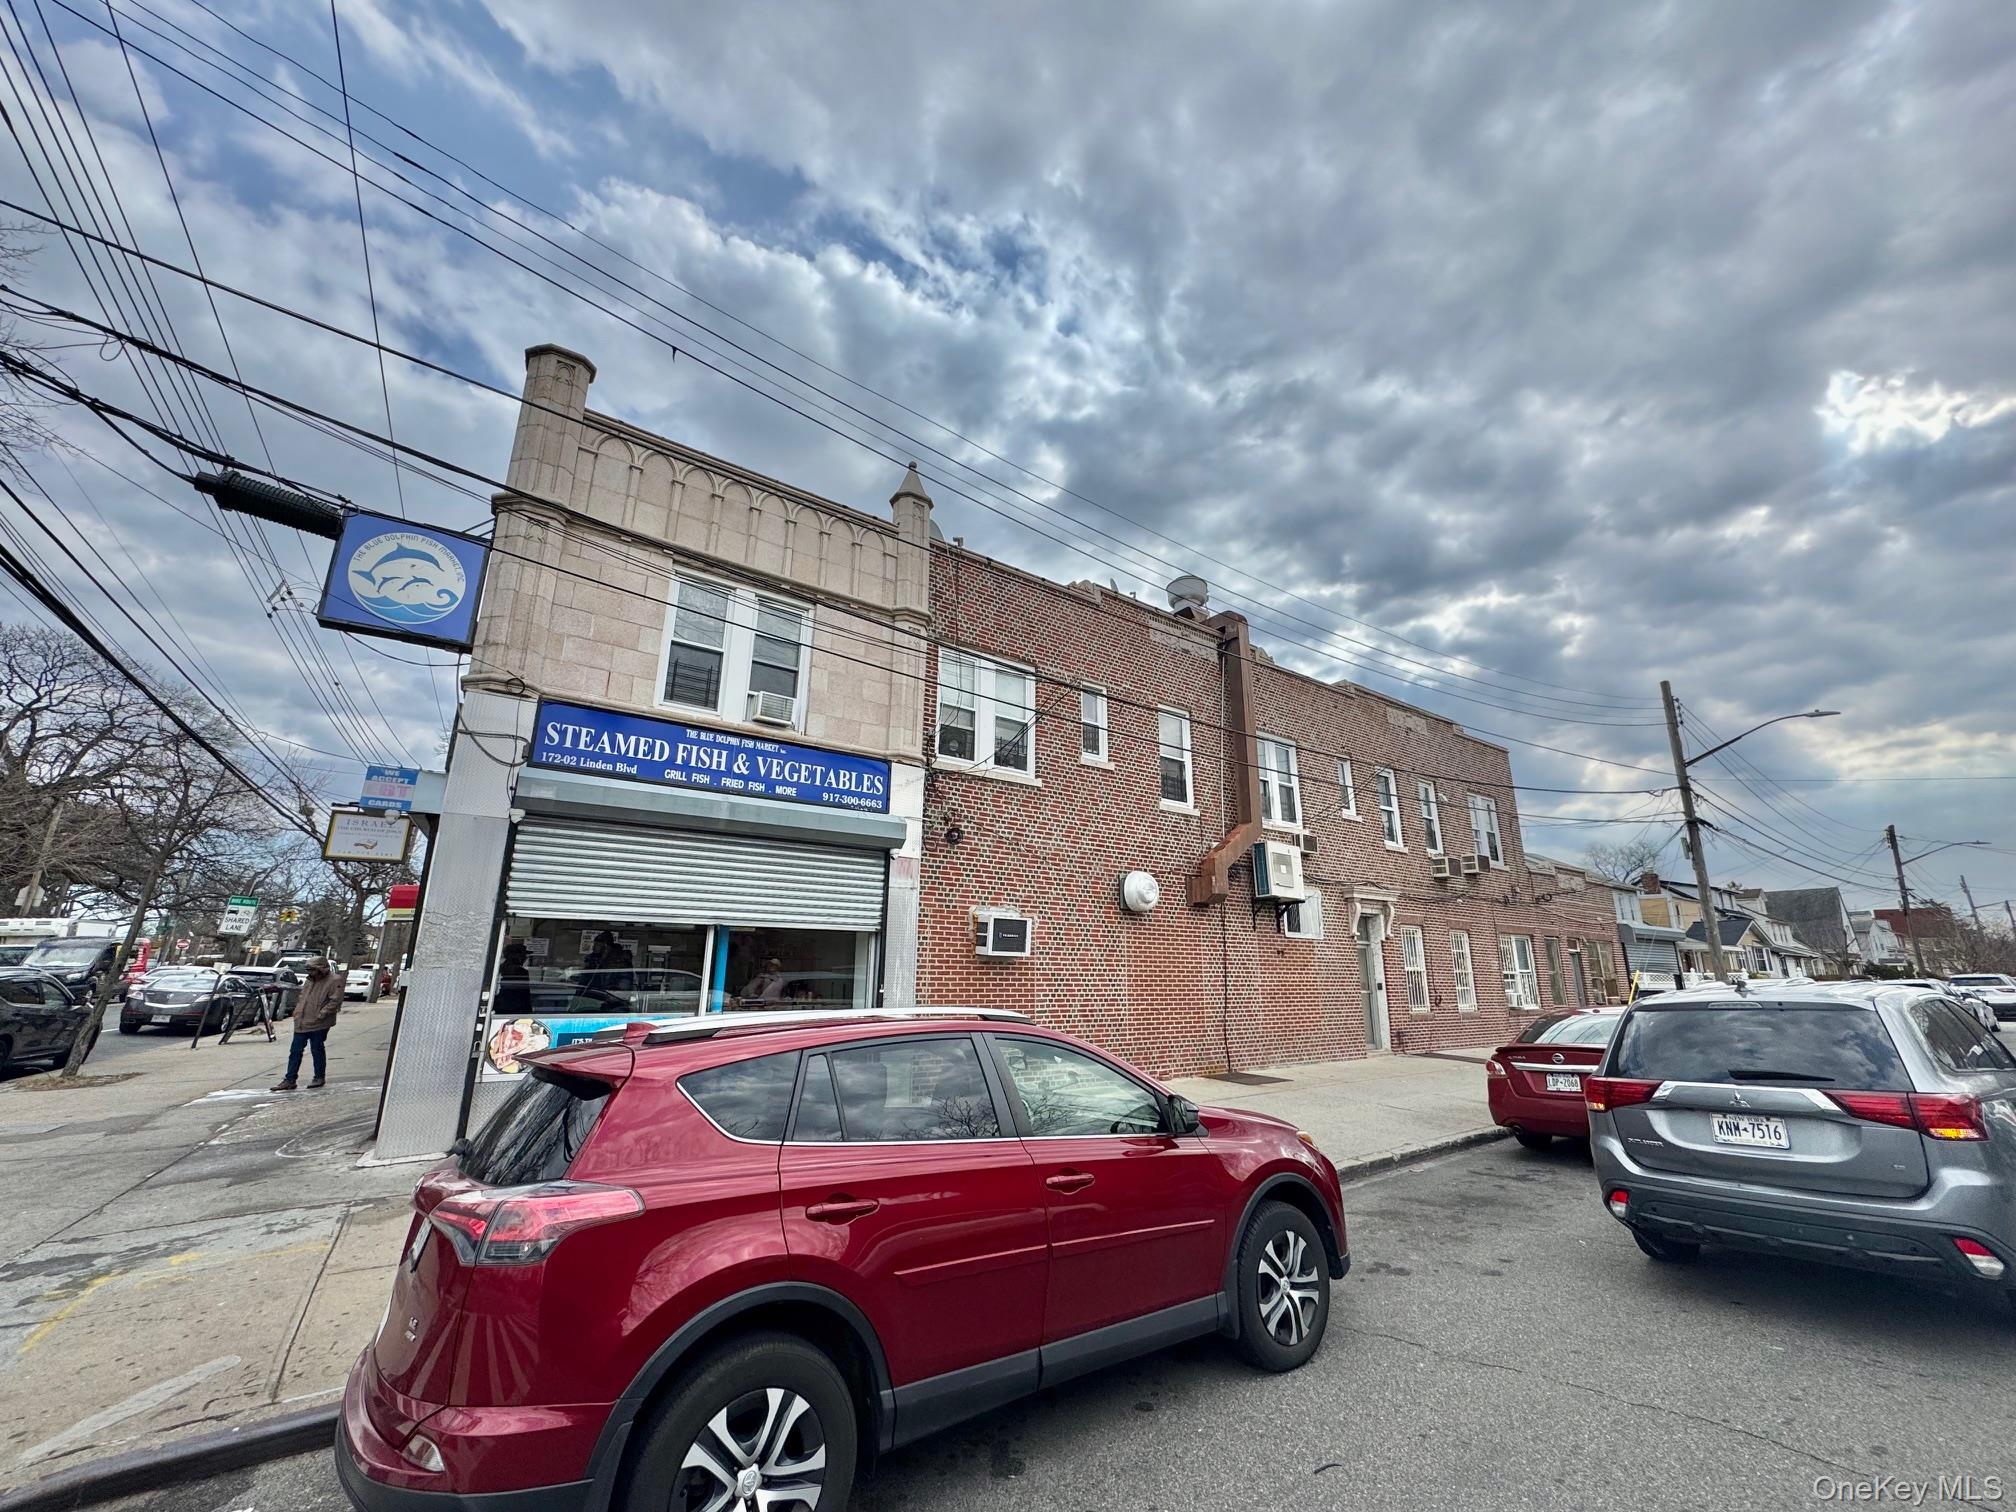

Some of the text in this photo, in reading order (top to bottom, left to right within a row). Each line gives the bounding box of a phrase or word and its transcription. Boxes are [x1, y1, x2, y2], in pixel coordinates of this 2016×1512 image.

[353, 550, 367, 562] THE
[365, 538, 383, 551] BLUE
[384, 533, 419, 542] DOLPHIN
[686, 729, 698, 739] THE
[700, 731, 714, 742] BLUE
[715, 734, 740, 746] DOLPHIN
[741, 738, 755, 749] FISH
[755, 741, 780, 753] MARKET
[541, 752, 638, 774] 172-02 Linden Blvd
[544, 721, 884, 795] STEAMED FISH & VEGETABLES
[371, 775, 409, 784] ACCEPT
[664, 769, 797, 796] GRILL FISH FRIED FISH MORE
[368, 799, 402, 808] CARDS
[822, 792, 882, 809] 917-300-6663
